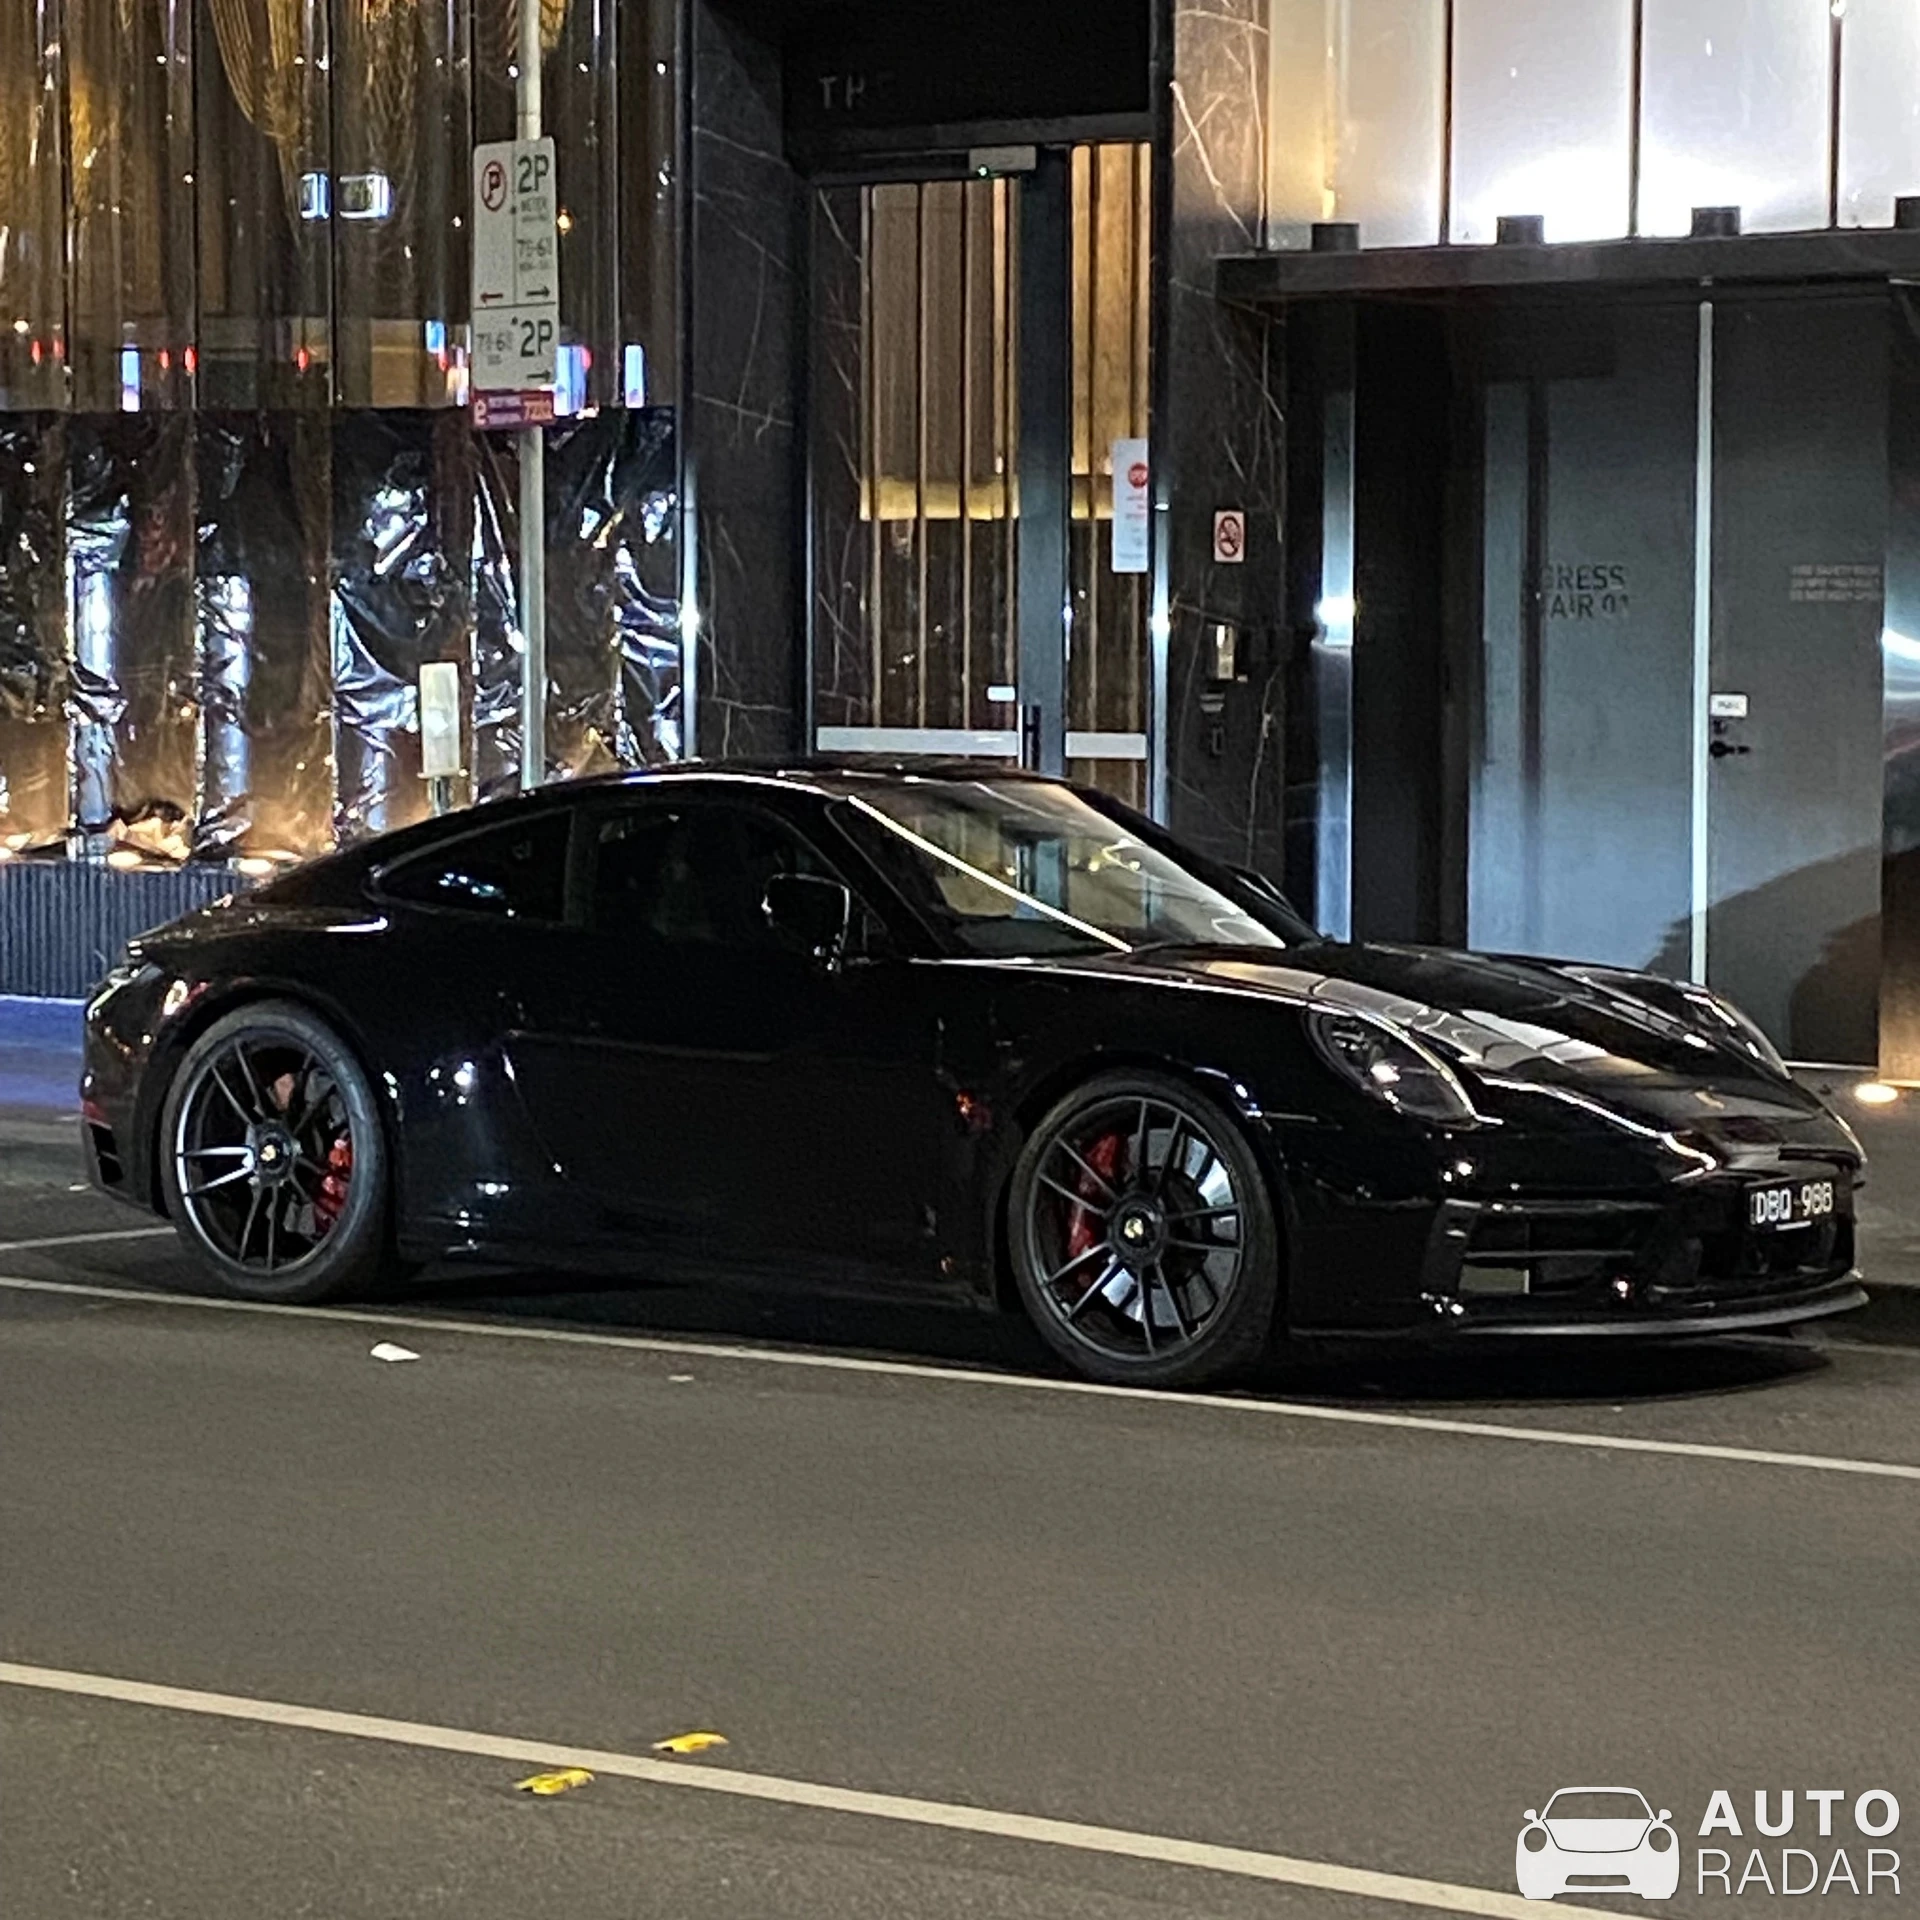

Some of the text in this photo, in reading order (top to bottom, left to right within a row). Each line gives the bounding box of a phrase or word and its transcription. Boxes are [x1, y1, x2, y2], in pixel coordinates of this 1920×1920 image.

[517, 154, 549, 193] 2P
[520, 319, 553, 357] 2P
[1547, 593, 1594, 619] AIR
